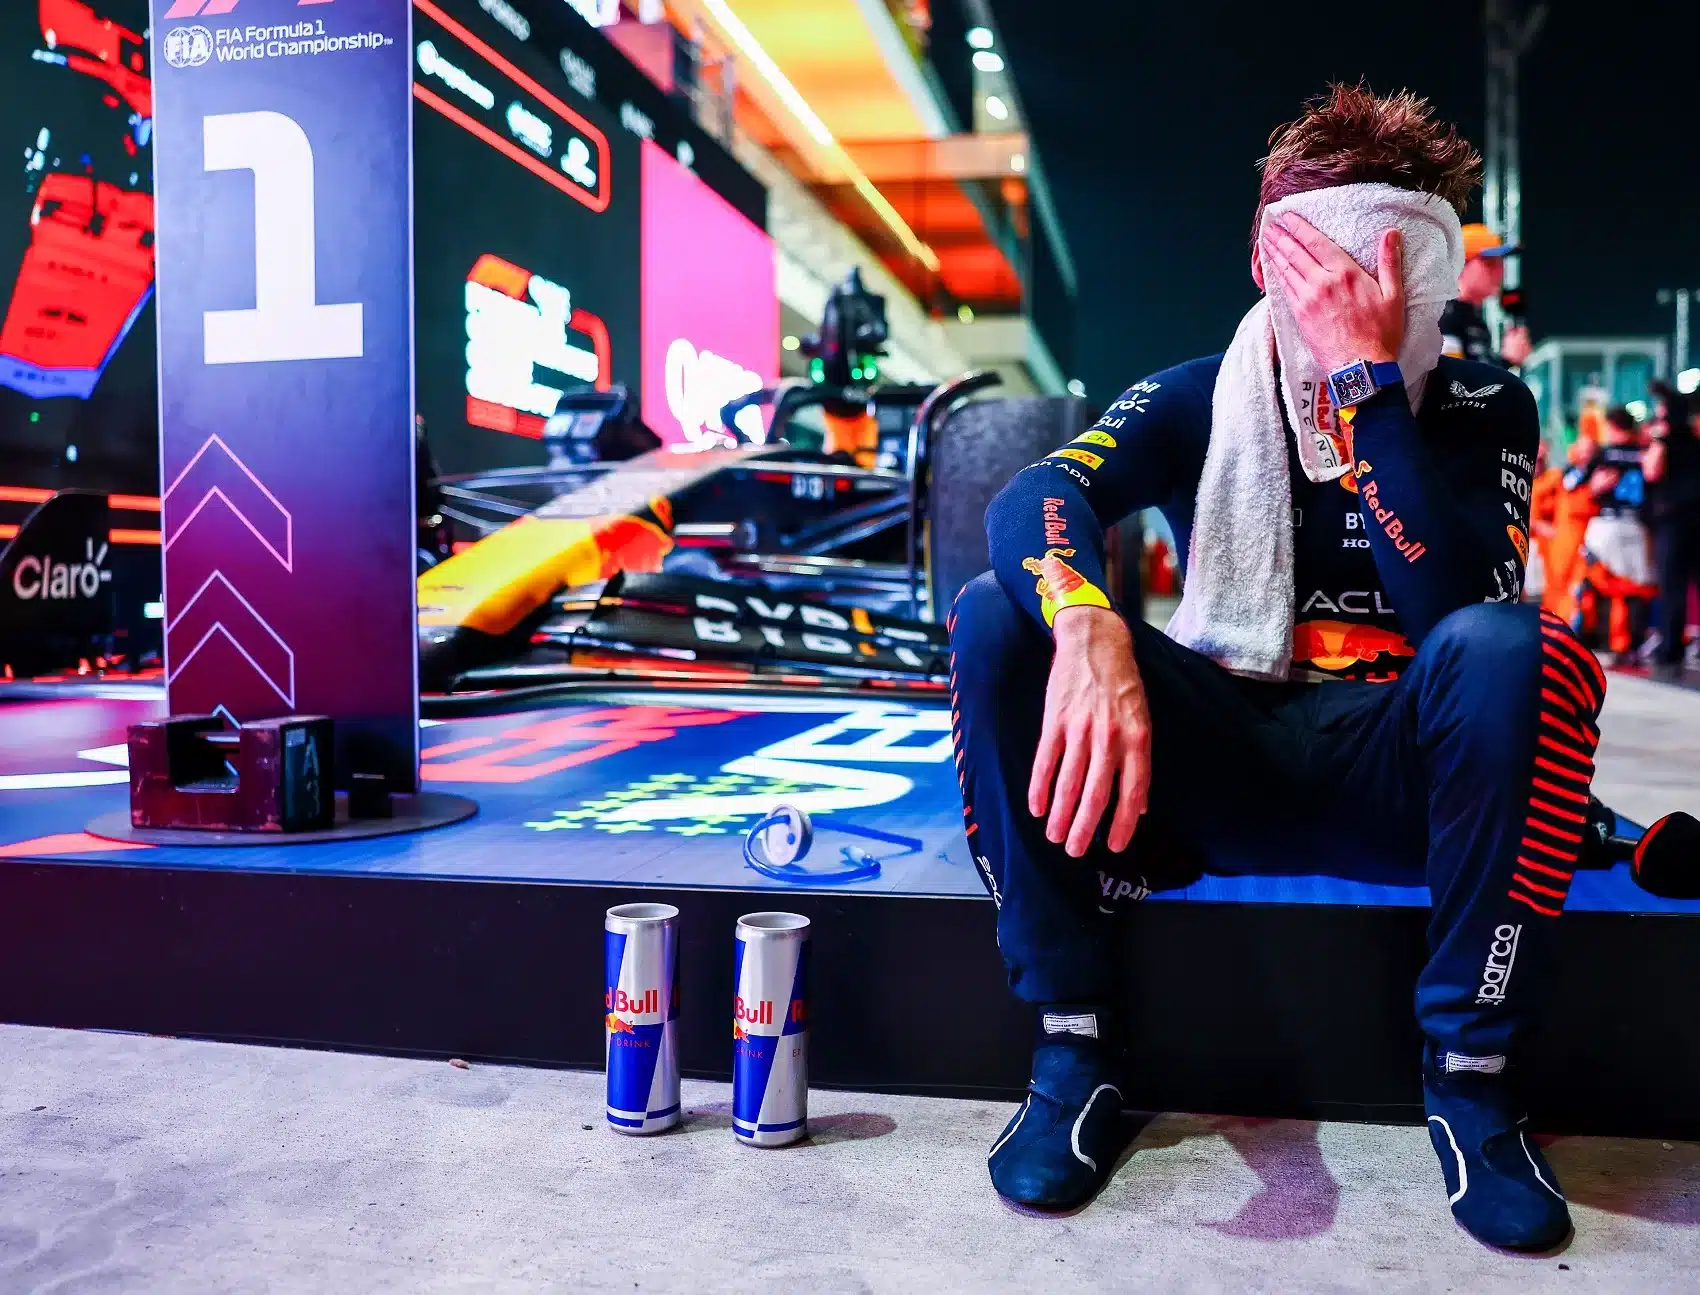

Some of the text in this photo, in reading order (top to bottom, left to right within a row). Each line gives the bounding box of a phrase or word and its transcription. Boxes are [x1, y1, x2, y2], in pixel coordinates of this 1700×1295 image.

[215, 19, 326, 46] FIA Formula 1
[215, 41, 265, 63] World
[203, 110, 364, 364] 1
[1342, 538, 1371, 549] HO
[13, 549, 104, 600] Claro
[1301, 589, 1396, 615] ACL
[615, 989, 658, 1014] Bull
[735, 996, 773, 1025] Bull
[616, 1037, 651, 1048] DRINK
